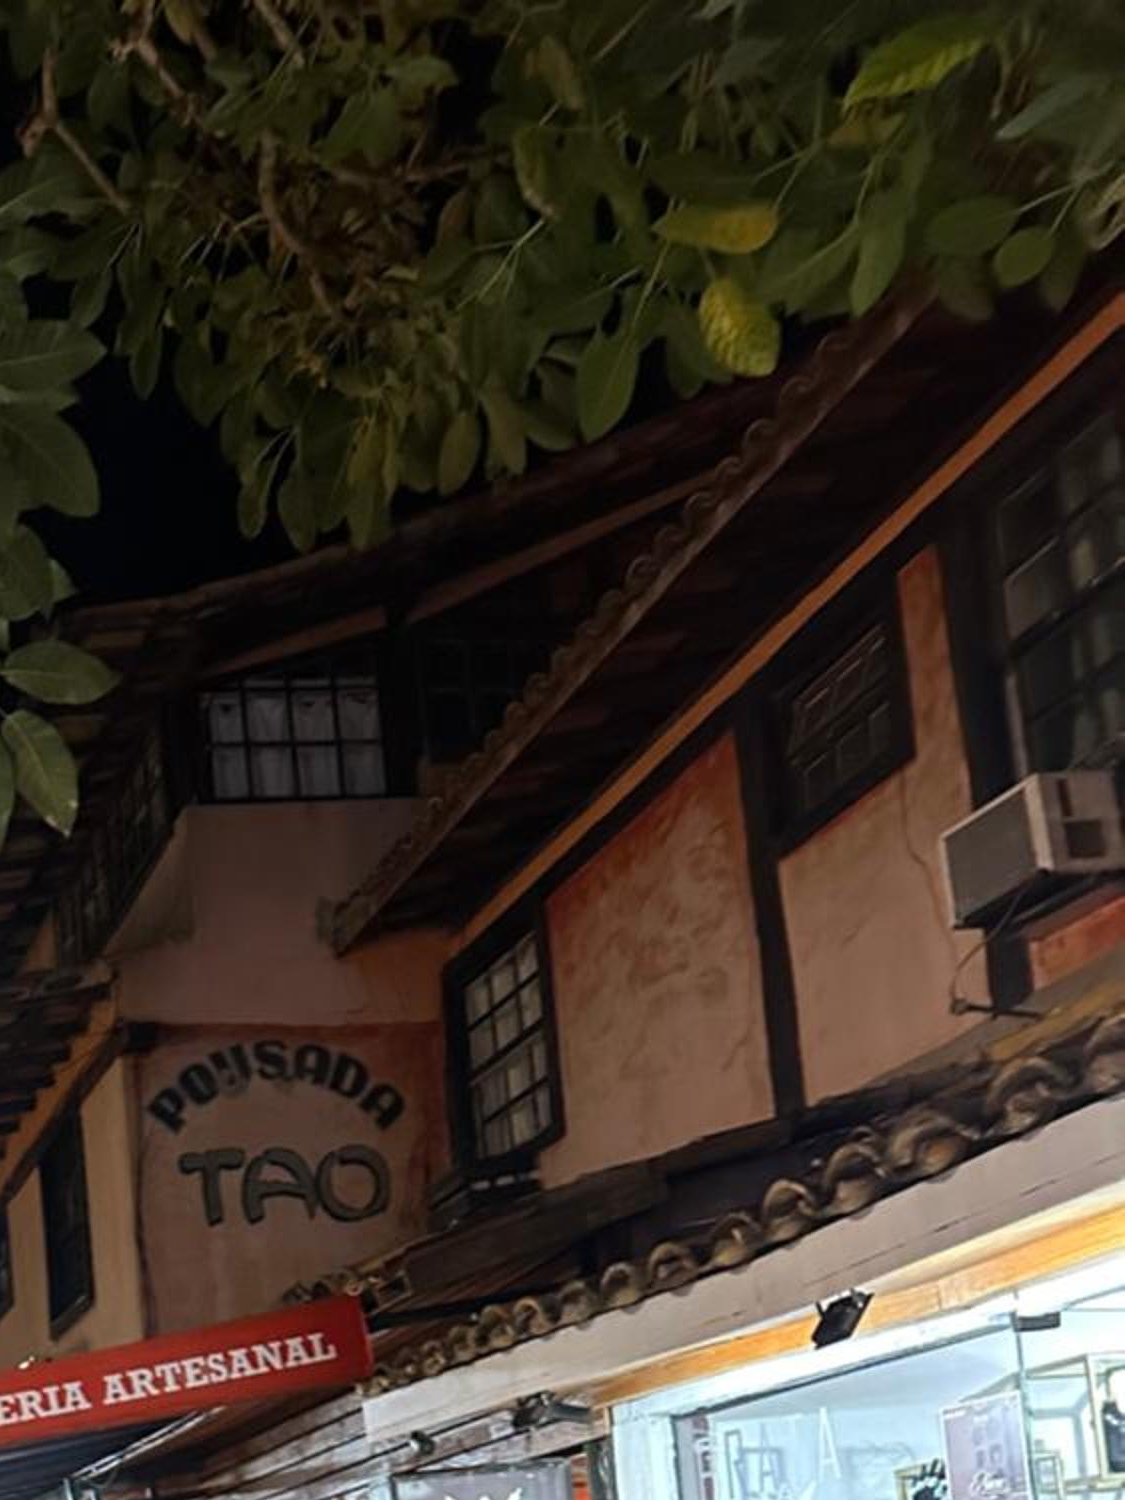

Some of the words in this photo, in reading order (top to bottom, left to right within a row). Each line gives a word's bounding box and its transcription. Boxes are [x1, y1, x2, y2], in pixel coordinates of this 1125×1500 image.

[147, 1039, 406, 1133] POUSADA
[178, 1145, 392, 1227] TAO
[102, 1332, 338, 1405] ARTESANAL
